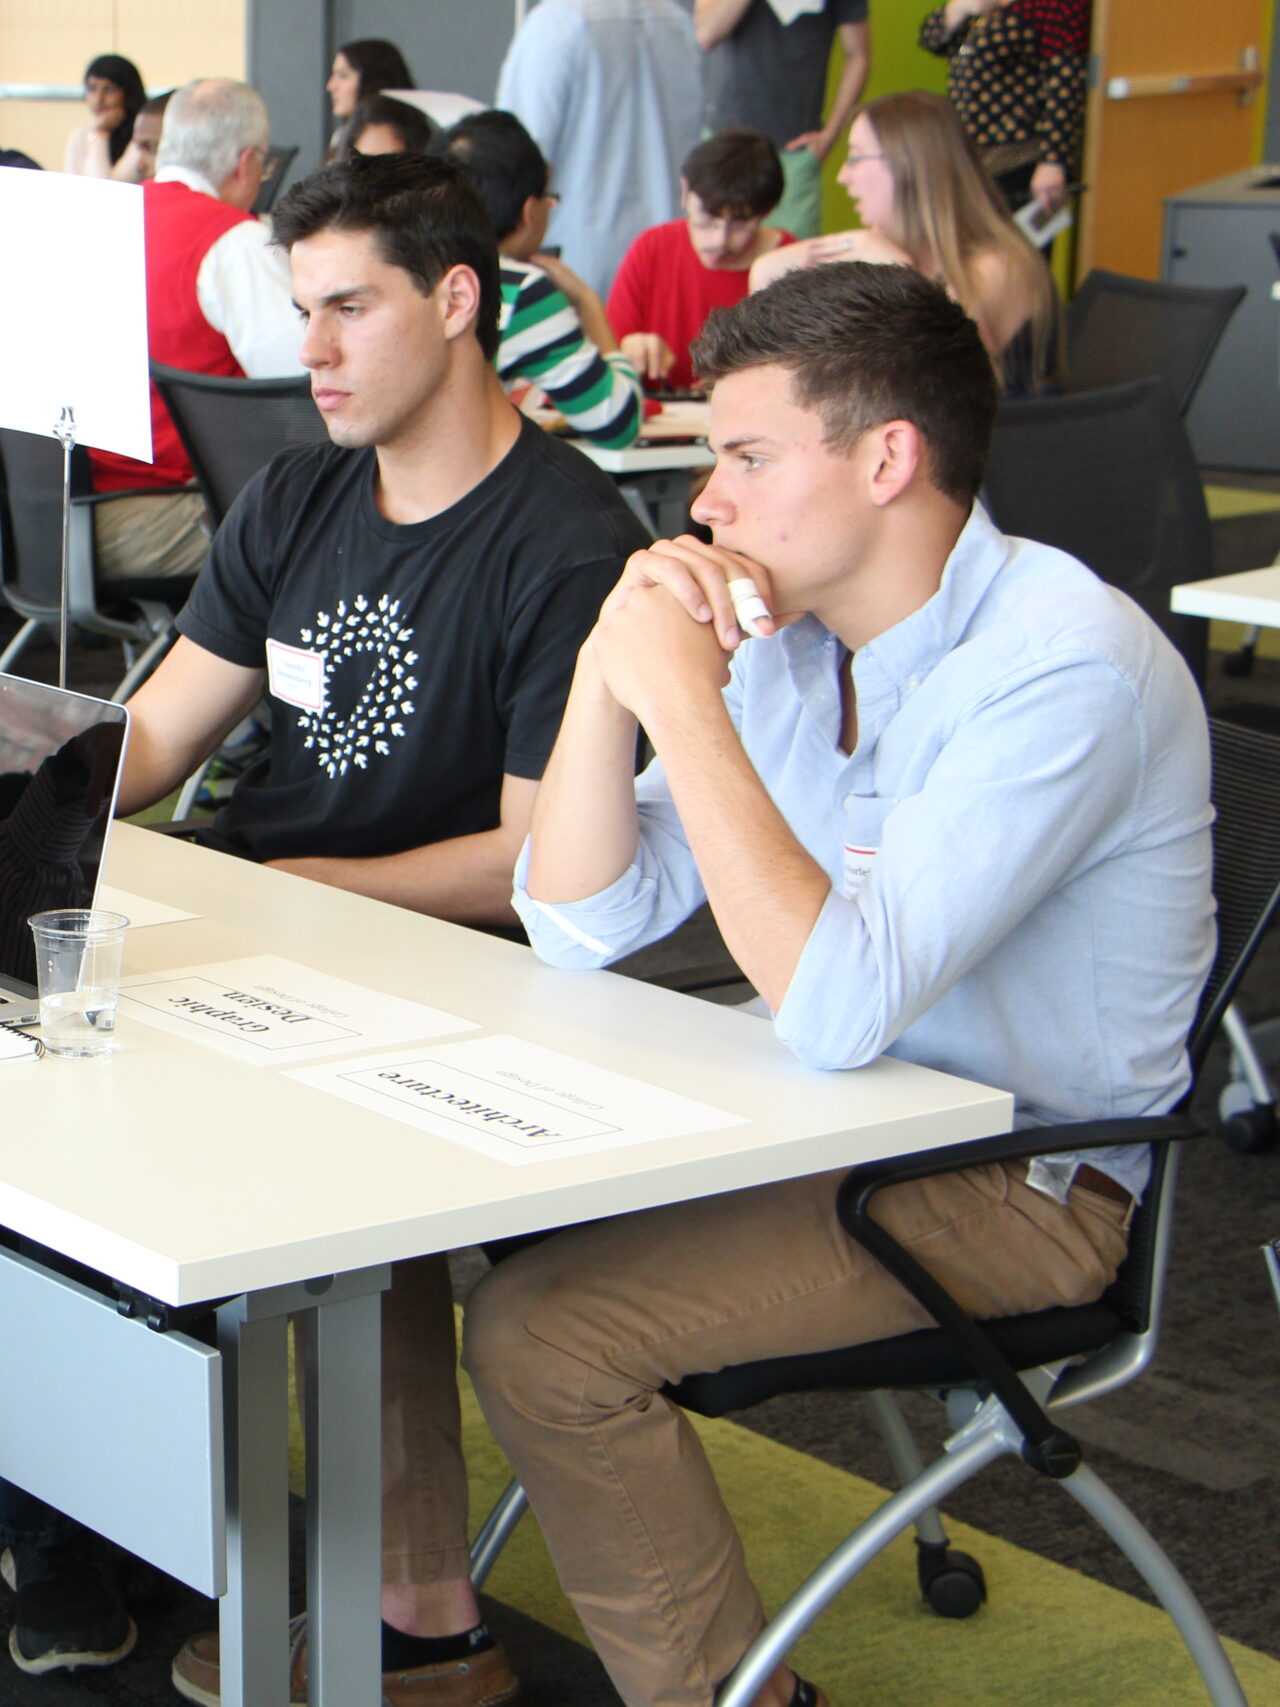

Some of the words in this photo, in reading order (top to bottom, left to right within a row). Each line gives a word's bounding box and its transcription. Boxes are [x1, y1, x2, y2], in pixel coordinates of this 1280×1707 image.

[168, 996, 270, 1033] Graphic
[222, 991, 313, 1024] Design
[377, 1071, 564, 1137] Architecture
